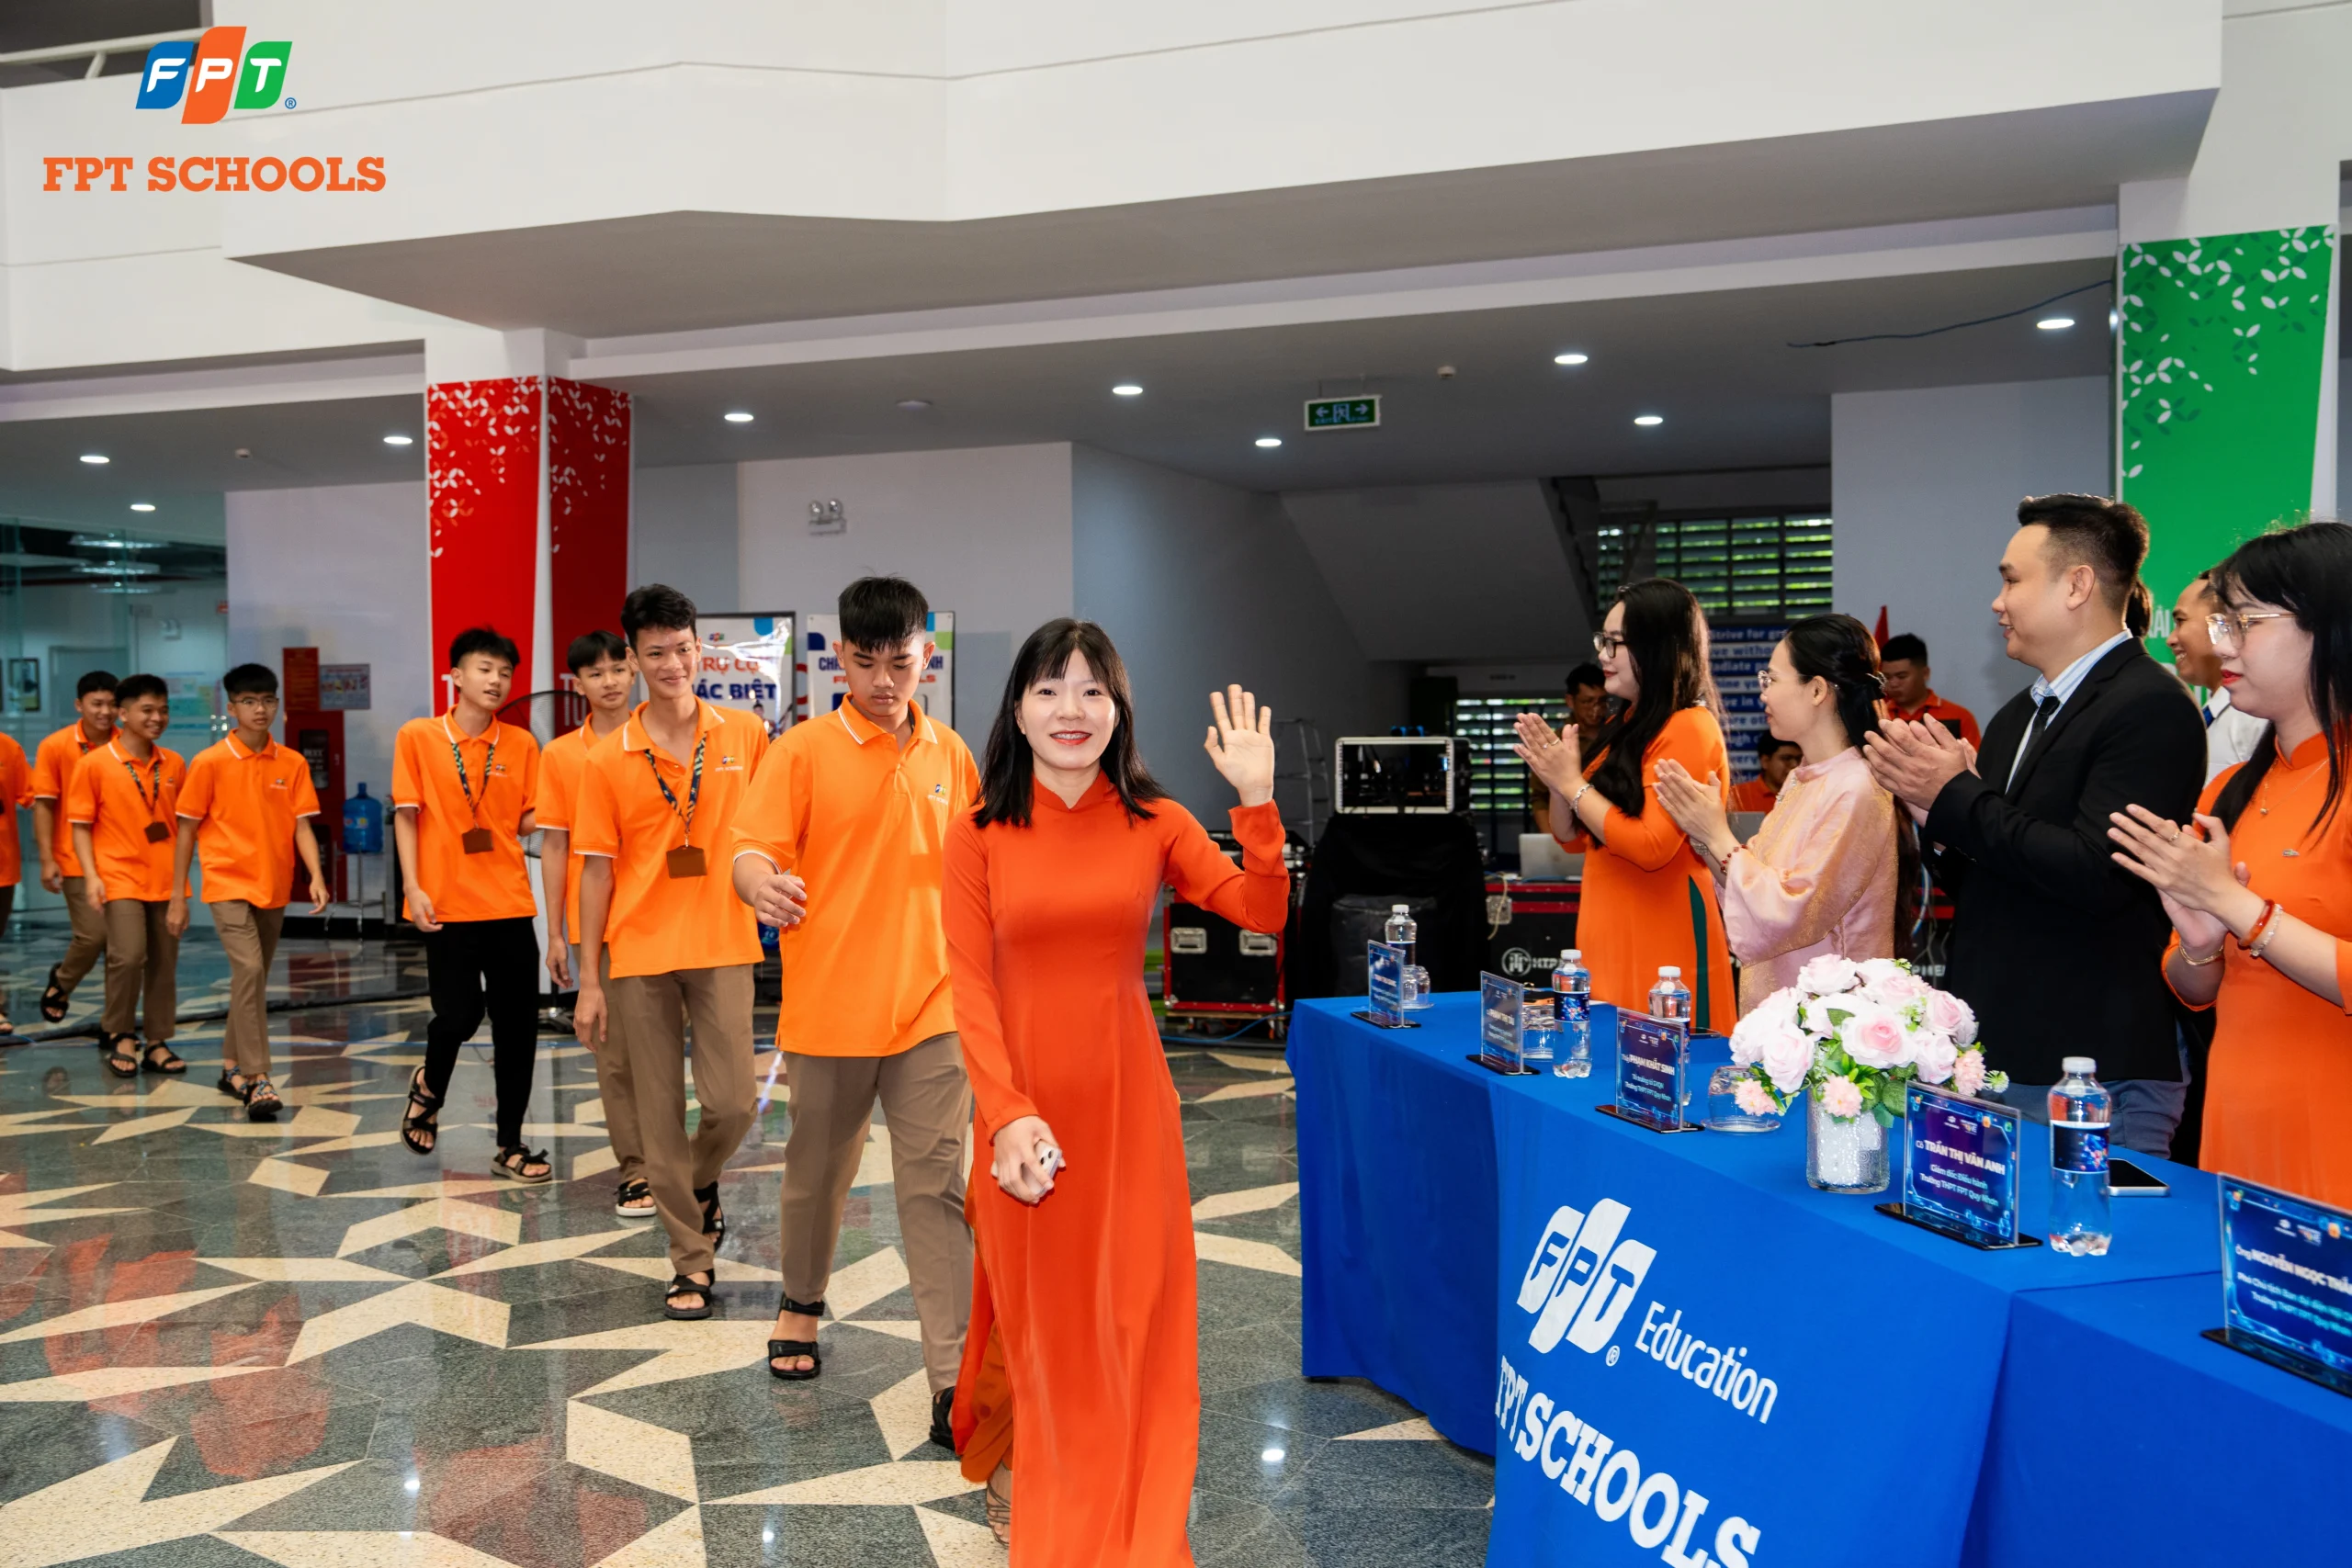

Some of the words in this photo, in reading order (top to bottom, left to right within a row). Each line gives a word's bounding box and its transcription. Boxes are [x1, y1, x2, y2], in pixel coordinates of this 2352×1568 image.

[1924, 1139, 1949, 1157] TRẦN
[1948, 1147, 1964, 1165] THỊ
[1963, 1152, 1984, 1169] VÂN
[1984, 1158, 2006, 1176] ANH
[1634, 1300, 1779, 1425] Education
[1514, 1392, 1762, 1568] SCHOOLS
